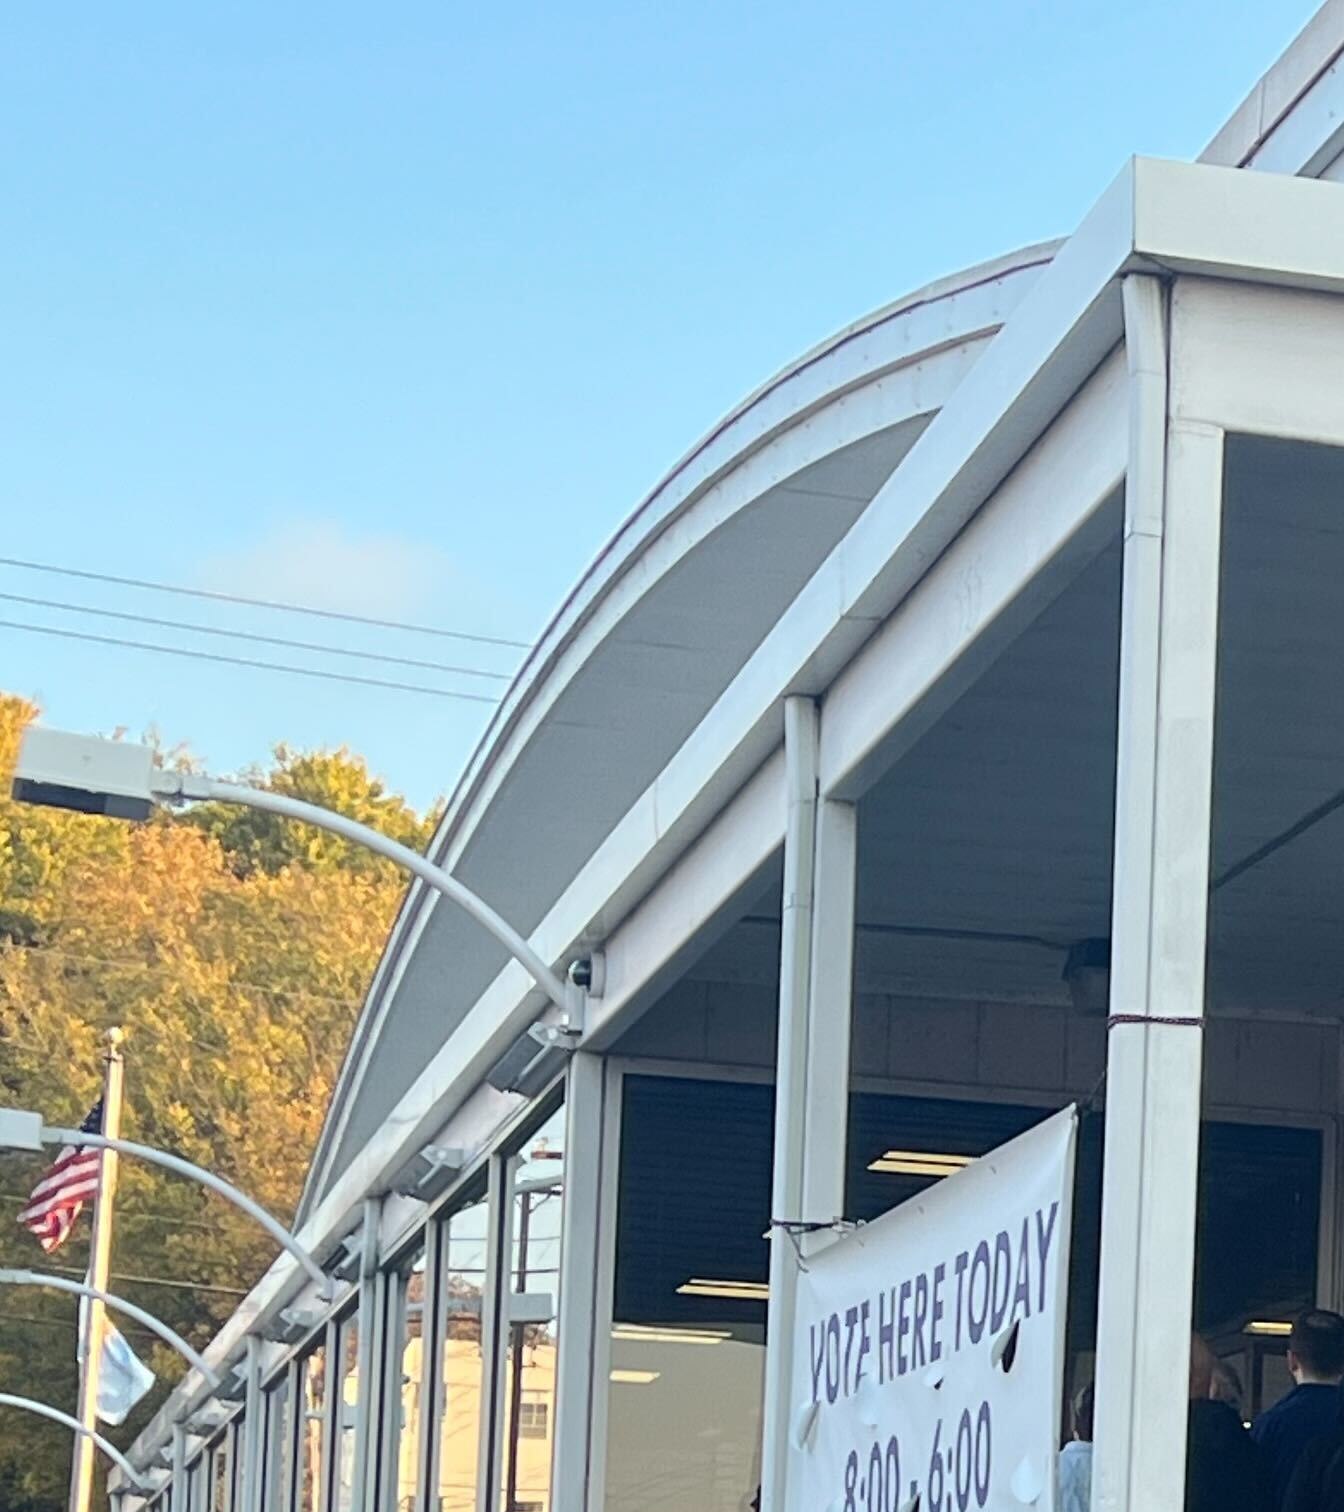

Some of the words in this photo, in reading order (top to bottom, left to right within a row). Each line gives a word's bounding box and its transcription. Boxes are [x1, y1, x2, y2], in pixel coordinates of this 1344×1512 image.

[810, 1299, 871, 1404] VOTE
[879, 1262, 946, 1385] HERE
[955, 1201, 1059, 1352] TODAY
